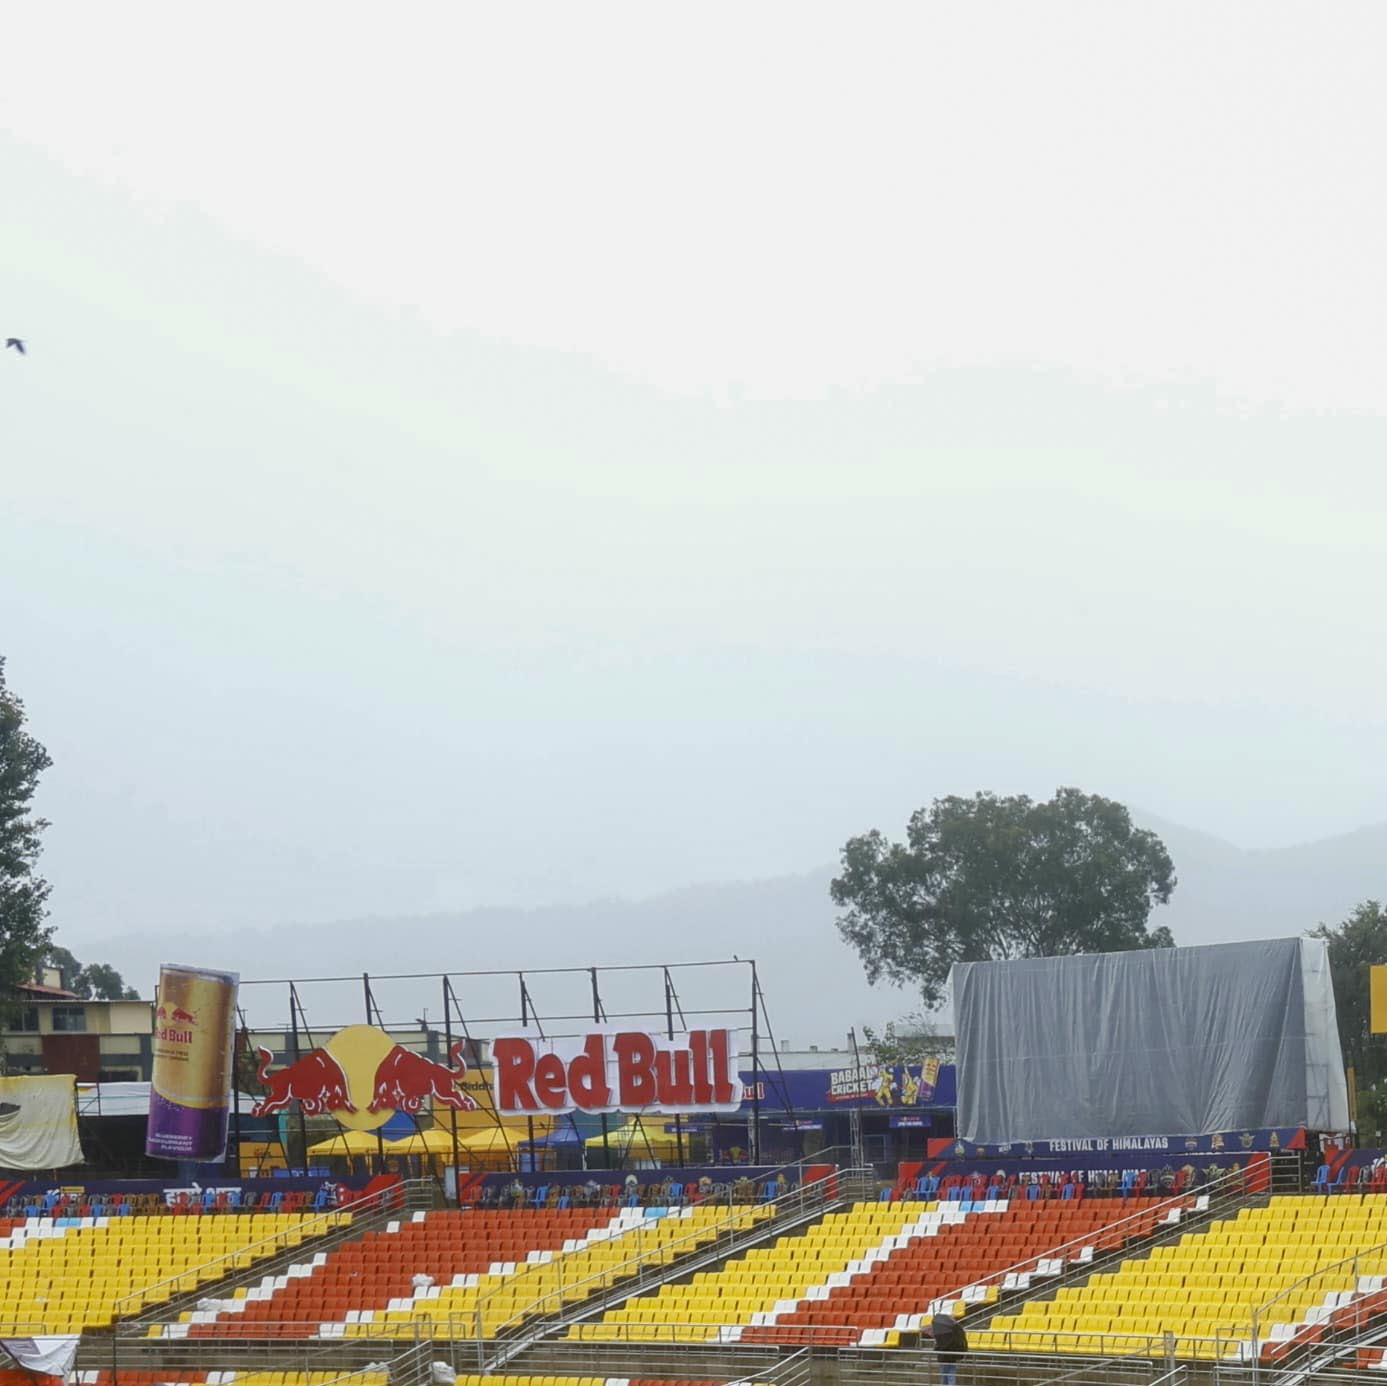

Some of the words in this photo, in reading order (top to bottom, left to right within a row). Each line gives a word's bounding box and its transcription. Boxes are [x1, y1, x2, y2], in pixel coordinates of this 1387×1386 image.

[169, 1030, 192, 1043] Bull
[493, 1034, 610, 1110] Red
[614, 1029, 734, 1105] Bull
[1049, 1140, 1093, 1152] FESTIVAL
[1096, 1139, 1109, 1151] OF
[1112, 1137, 1169, 1150] HIMALAYAS
